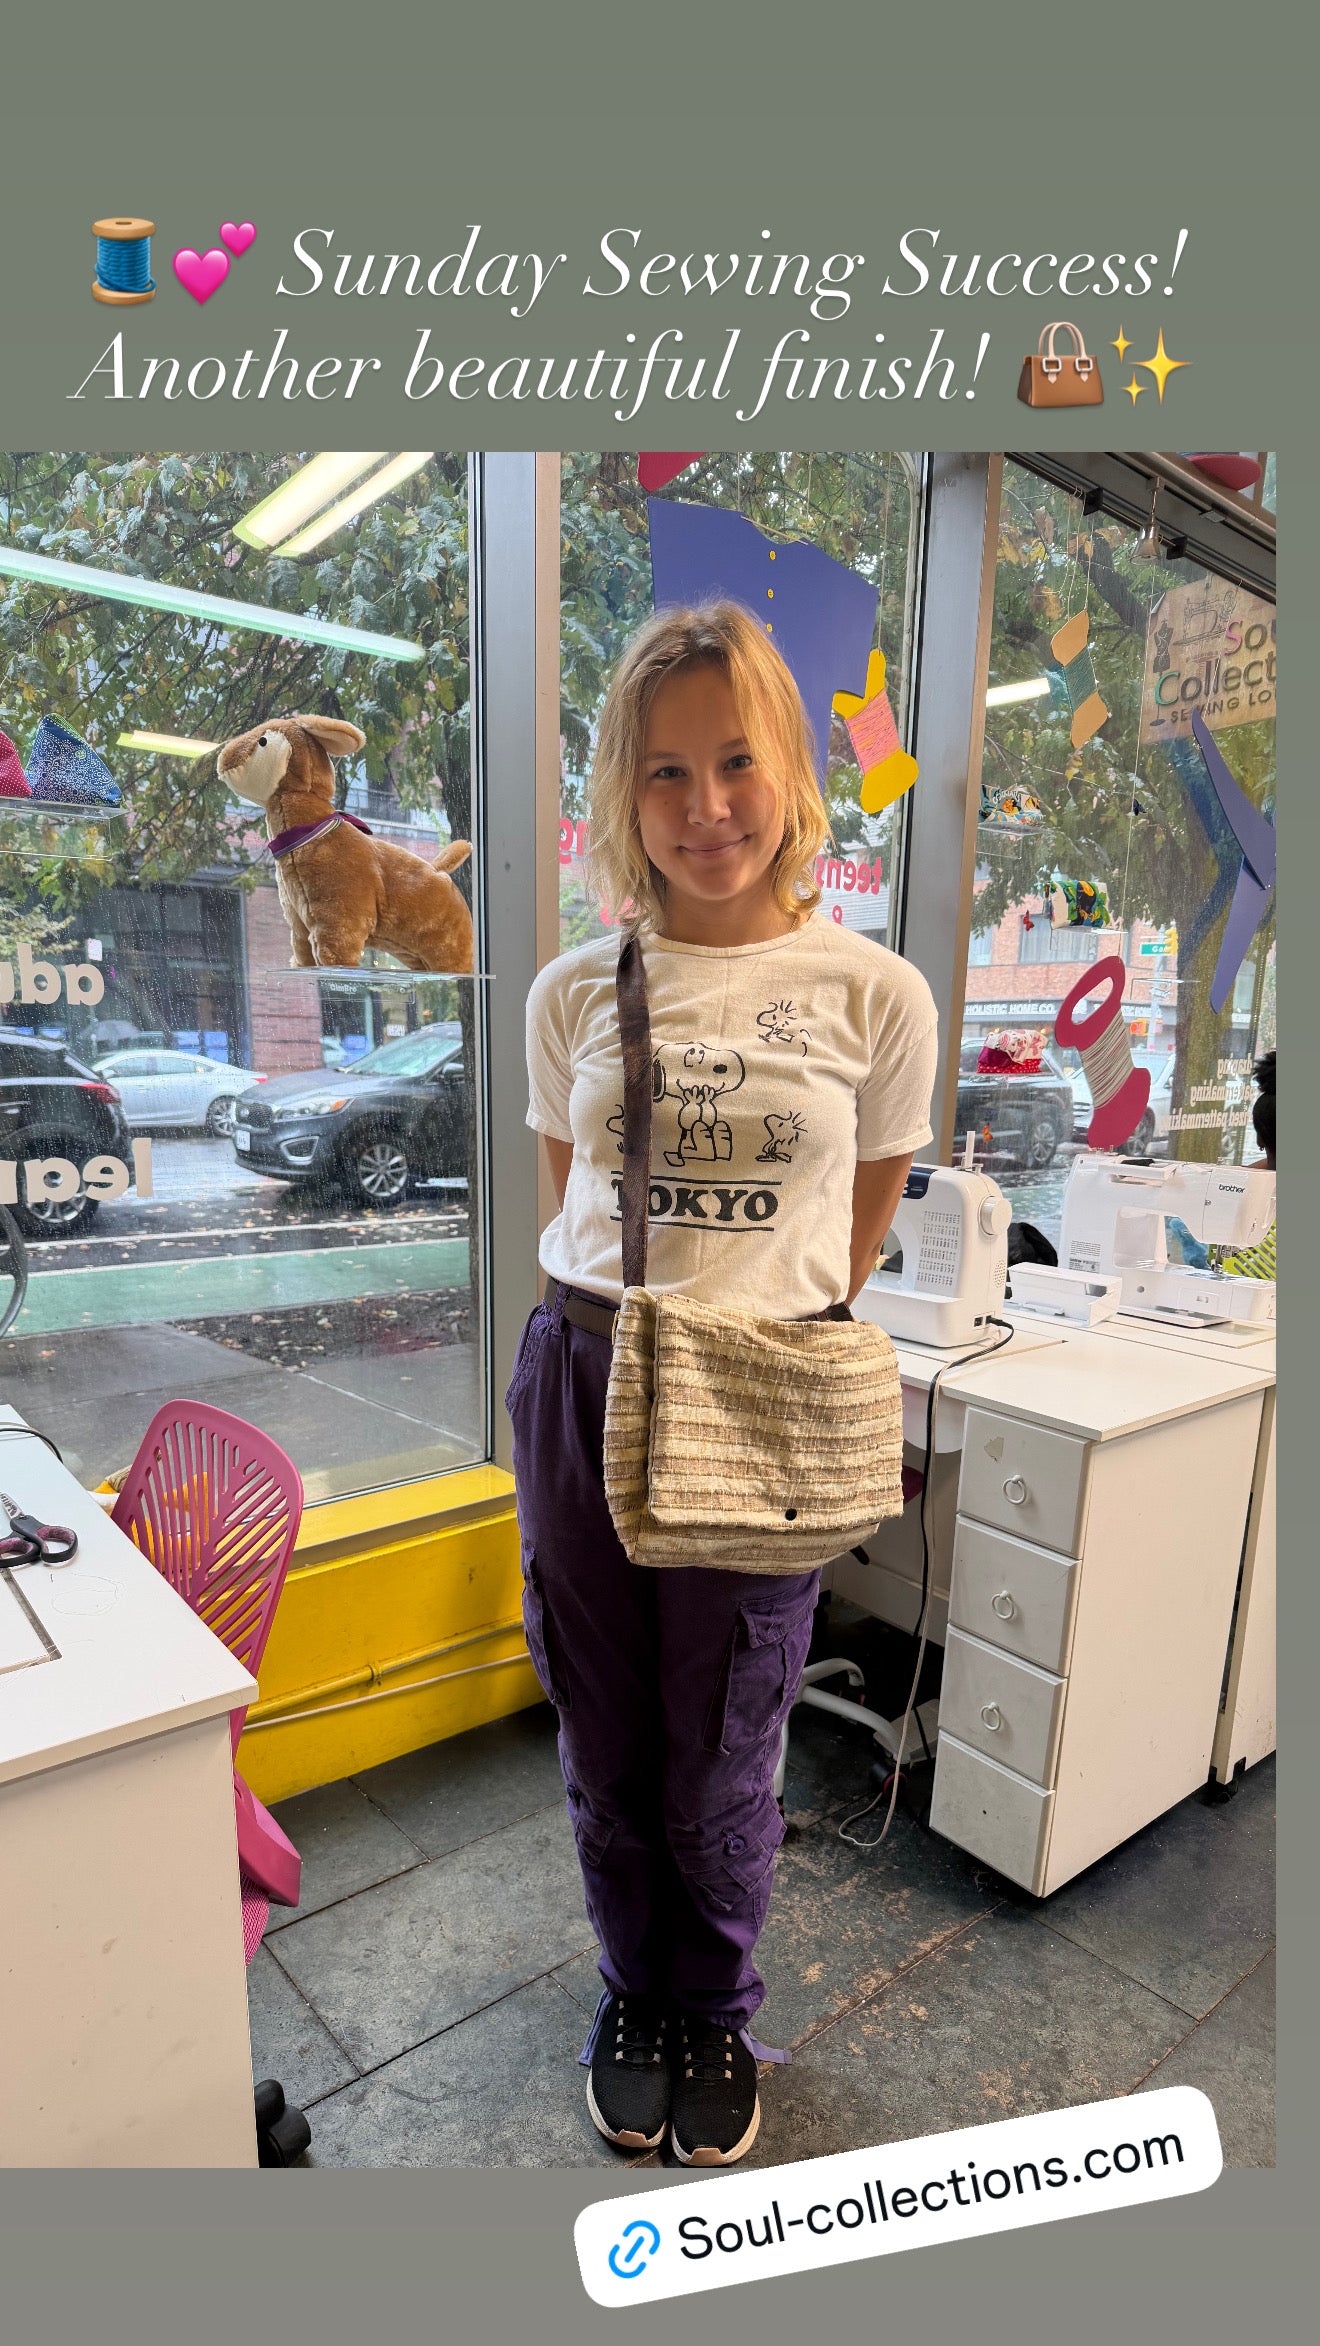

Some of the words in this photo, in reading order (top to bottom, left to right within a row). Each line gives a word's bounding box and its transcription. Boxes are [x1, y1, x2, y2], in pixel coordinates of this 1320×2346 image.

[1224, 619, 1276, 656] So
[1249, 689, 1276, 706] LO
[965, 1004, 1008, 1015] HOLISTIC
[1009, 1003, 1038, 1015] HOME
[1218, 1184, 1245, 1194] brother
